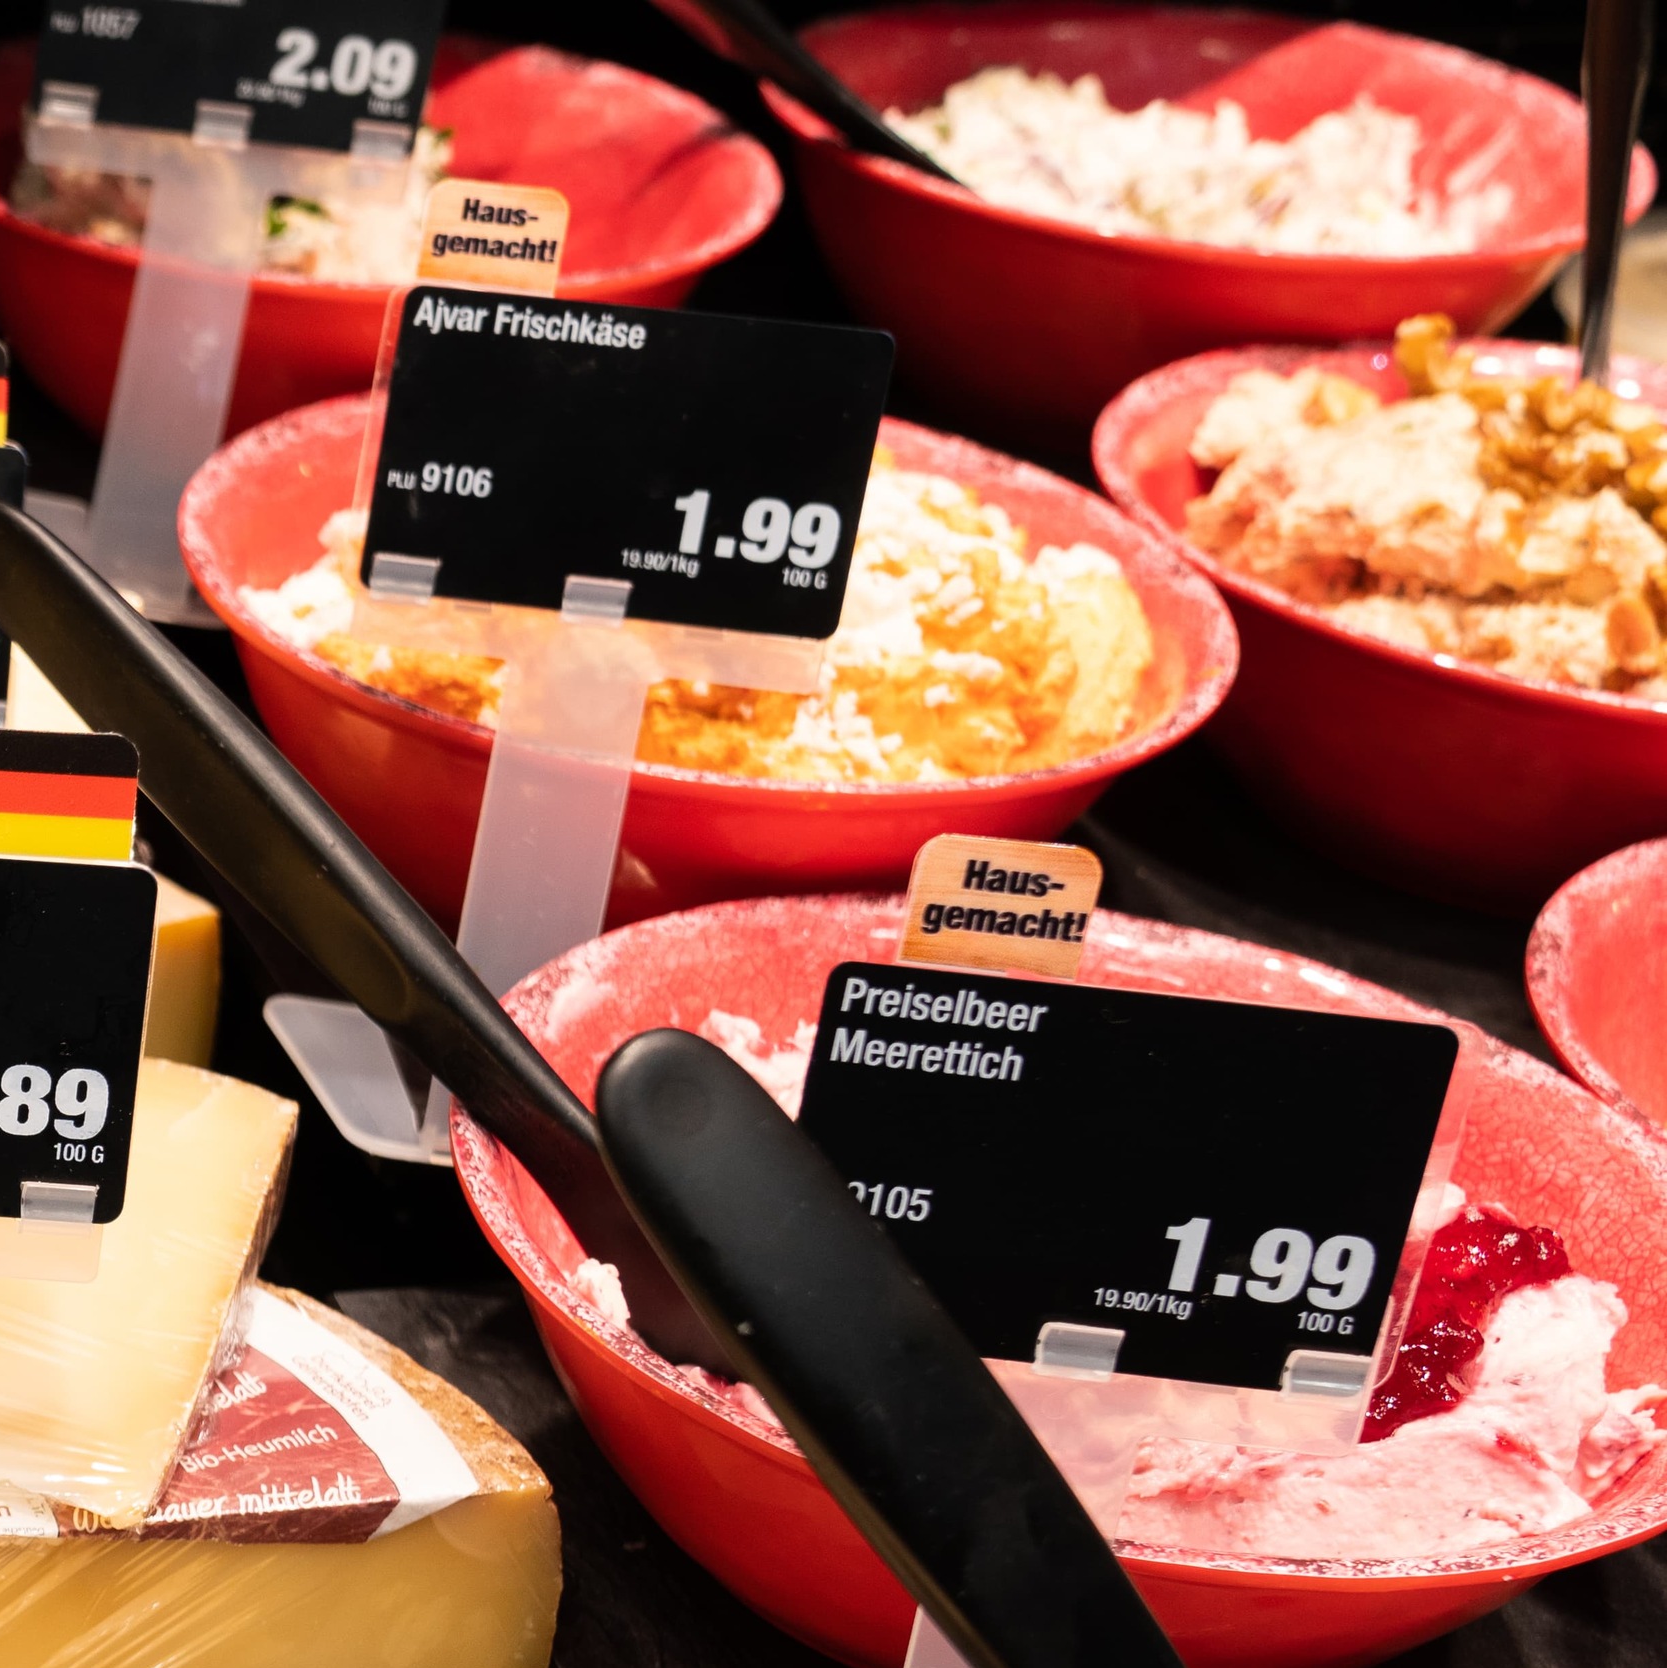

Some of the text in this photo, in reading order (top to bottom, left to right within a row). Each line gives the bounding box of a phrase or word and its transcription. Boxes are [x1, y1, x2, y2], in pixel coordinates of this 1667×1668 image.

[269, 27, 418, 99] 2.09
[461, 197, 539, 226] Haus-
[432, 230, 556, 264] gemacht!
[414, 297, 646, 349] Ajvar Frischkäse
[421, 463, 492, 497] 9106
[673, 489, 842, 569] 1.99
[783, 568, 811, 587] 100
[963, 858, 1065, 897] Haus-
[921, 901, 1086, 943] gemacht!
[841, 978, 1048, 1032] Preiselbeer
[830, 1028, 1023, 1081] Meerettich
[54, 1143, 104, 1163] 100 G
[1164, 1217, 1377, 1310] 1.99
[1094, 1288, 1192, 1320] 19.90/1kg
[1298, 1312, 1334, 1332] 100
[179, 1423, 338, 1473] Bio-Heumilch
[238, 1471, 362, 1515] mittelalt
